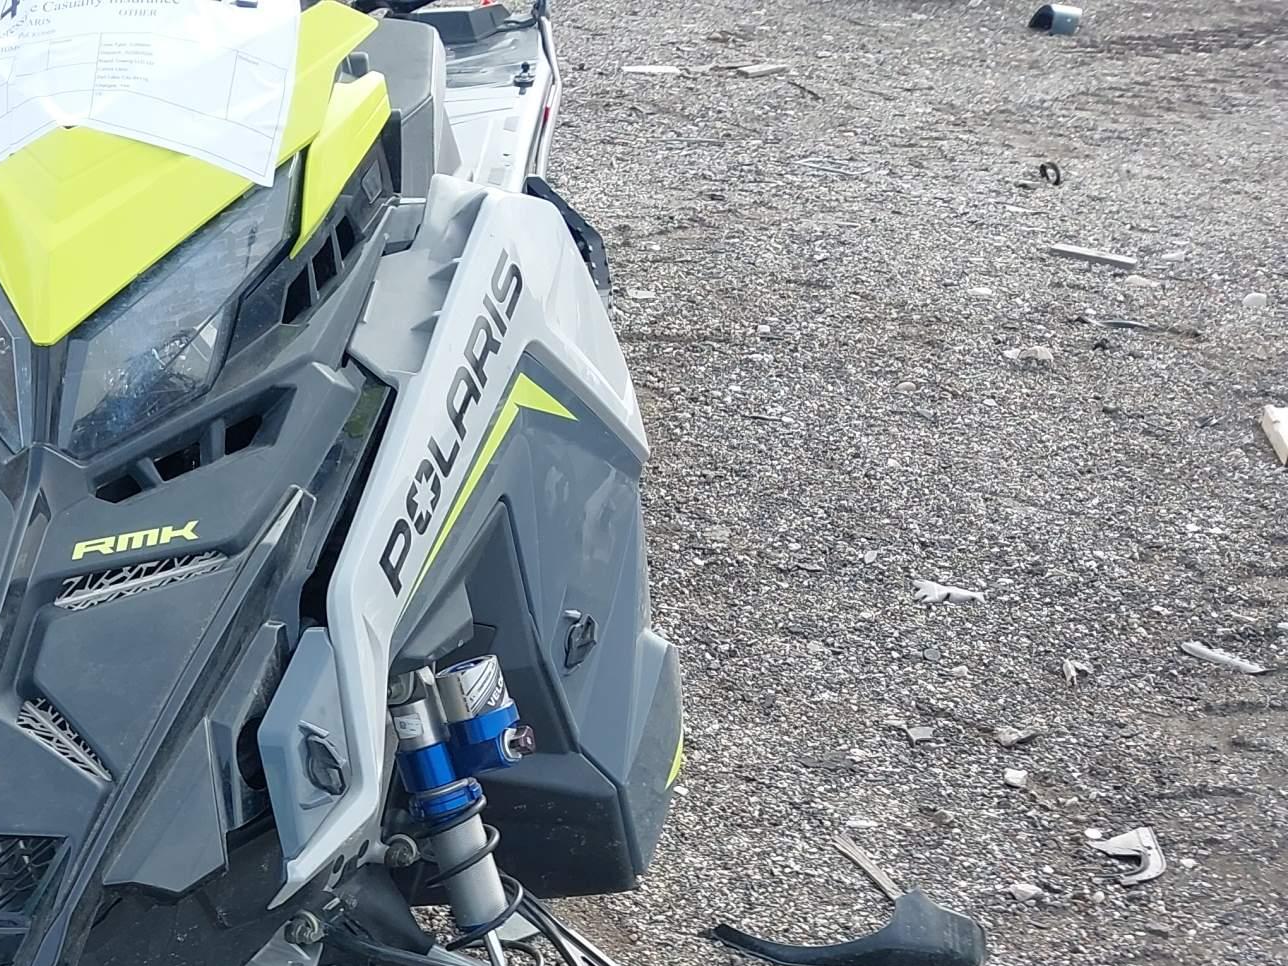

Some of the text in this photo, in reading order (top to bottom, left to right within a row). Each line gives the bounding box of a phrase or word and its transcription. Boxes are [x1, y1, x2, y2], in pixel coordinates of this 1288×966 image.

[118, 8, 158, 17] OTHER
[379, 247, 523, 598] POLARIS
[71, 520, 200, 561] RMK
